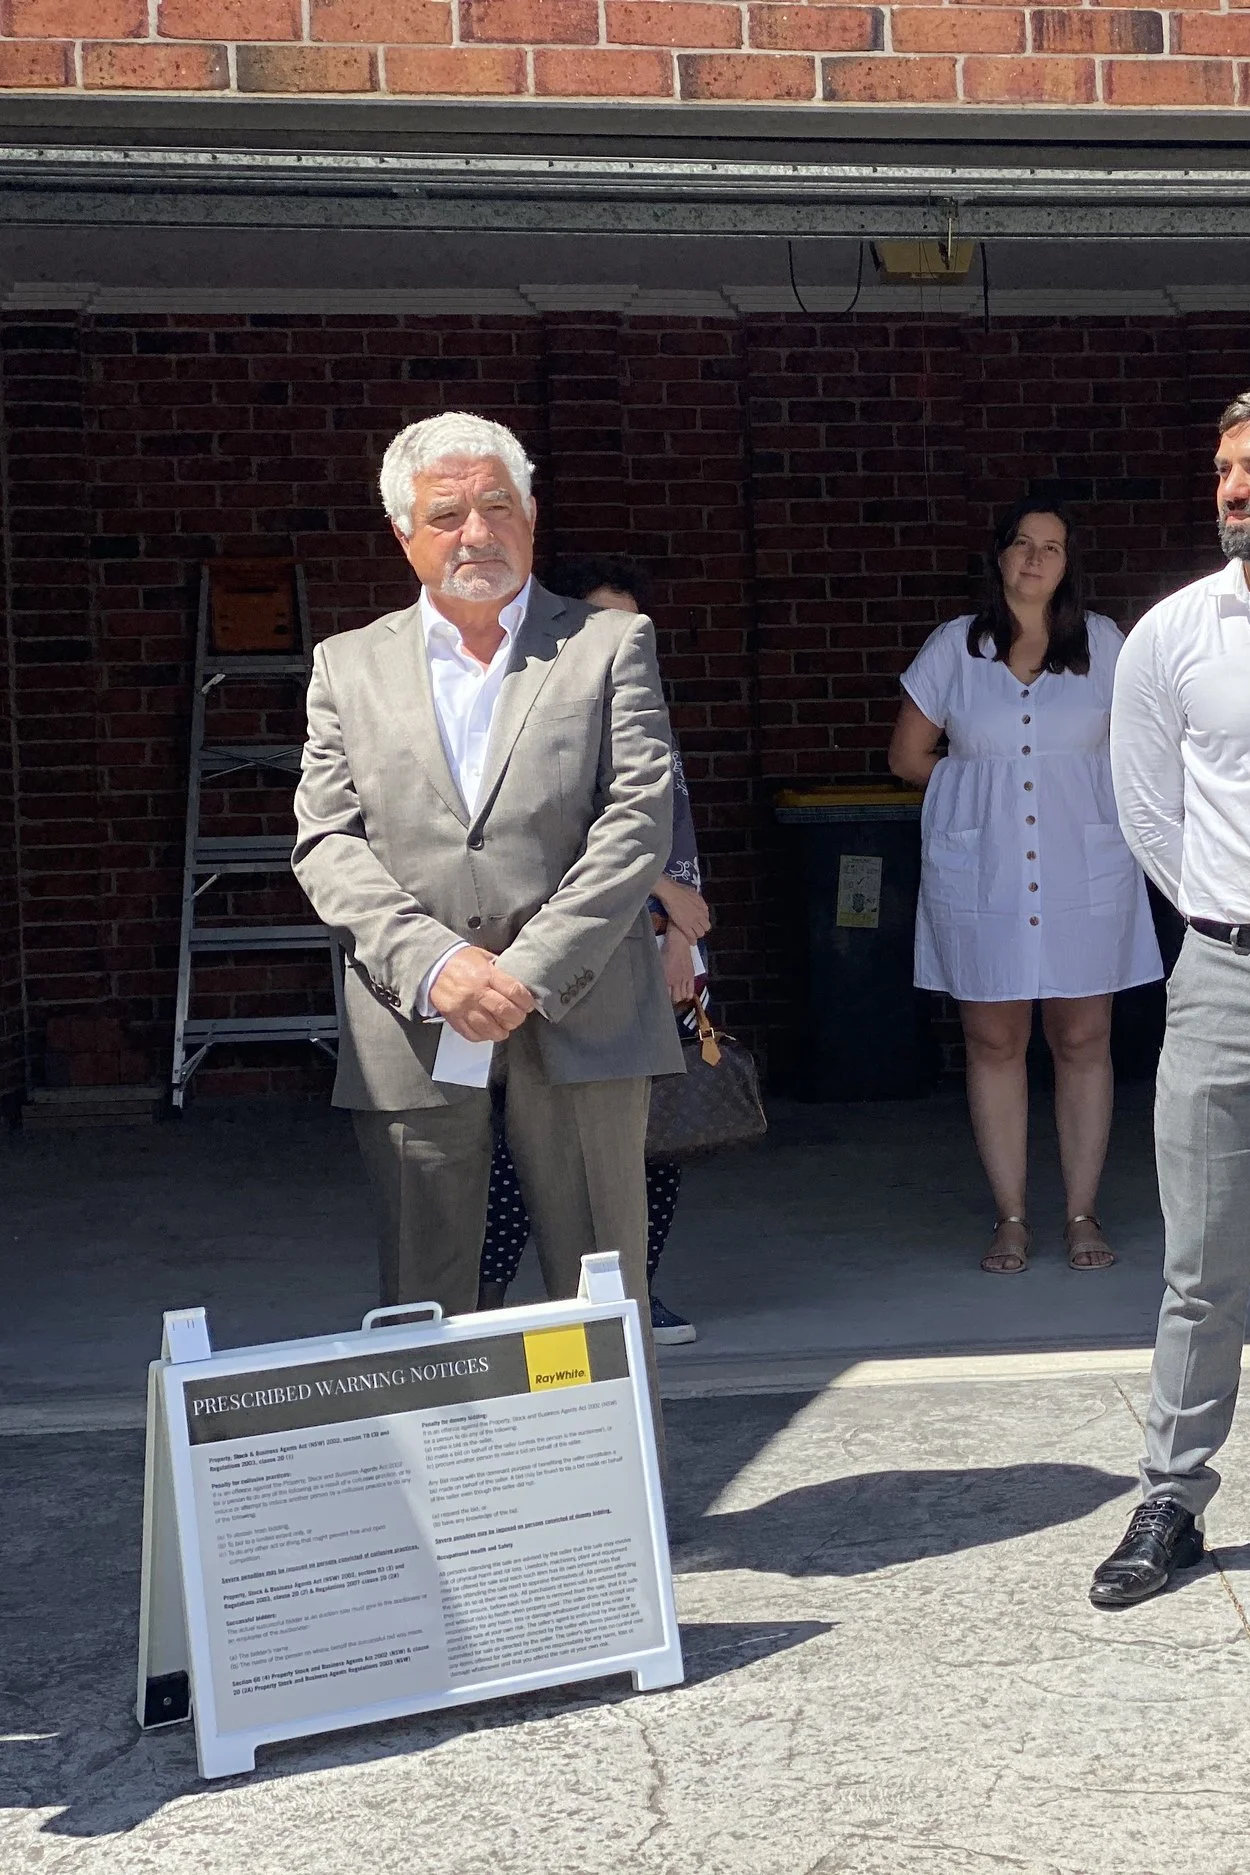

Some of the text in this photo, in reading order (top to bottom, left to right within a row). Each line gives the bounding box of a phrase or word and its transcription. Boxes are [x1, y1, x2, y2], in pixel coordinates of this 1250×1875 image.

[193, 1357, 489, 1416] PRESCRIBED WARNING NOTICES
